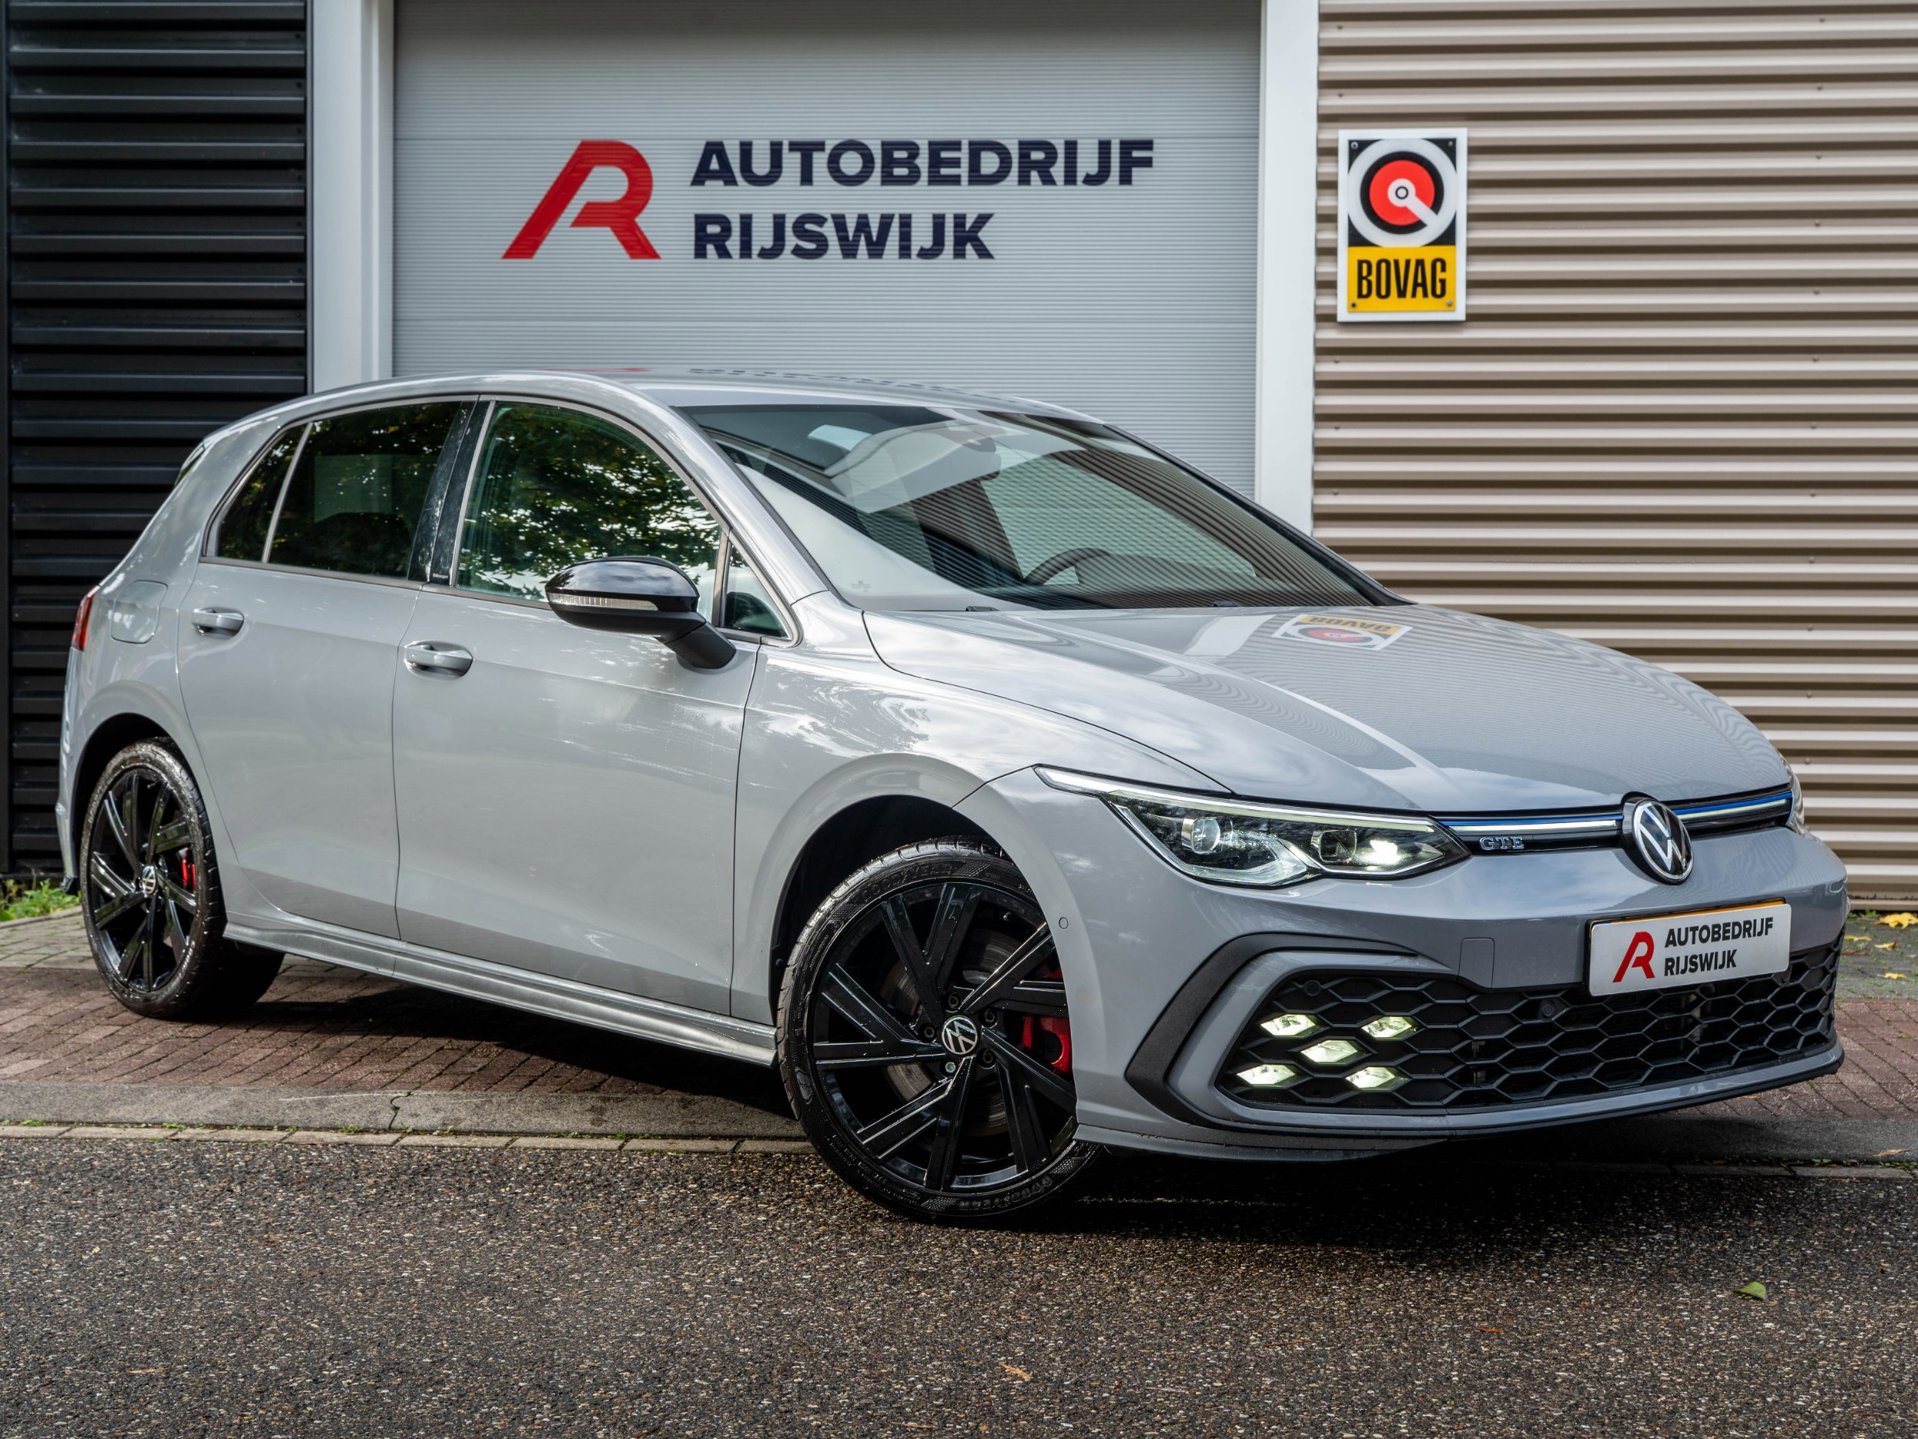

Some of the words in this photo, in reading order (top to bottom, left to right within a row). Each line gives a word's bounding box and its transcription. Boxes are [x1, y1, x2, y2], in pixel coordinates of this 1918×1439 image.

[690, 138, 1154, 186] AUTOBEDRIJF
[694, 213, 996, 259] RIJSWIJK
[1357, 257, 1447, 299] BOVAG
[1479, 836, 1525, 850] GTE
[1664, 917, 1774, 948] AUTOBEDRIJF
[1664, 949, 1738, 977] RIJSWIJK
